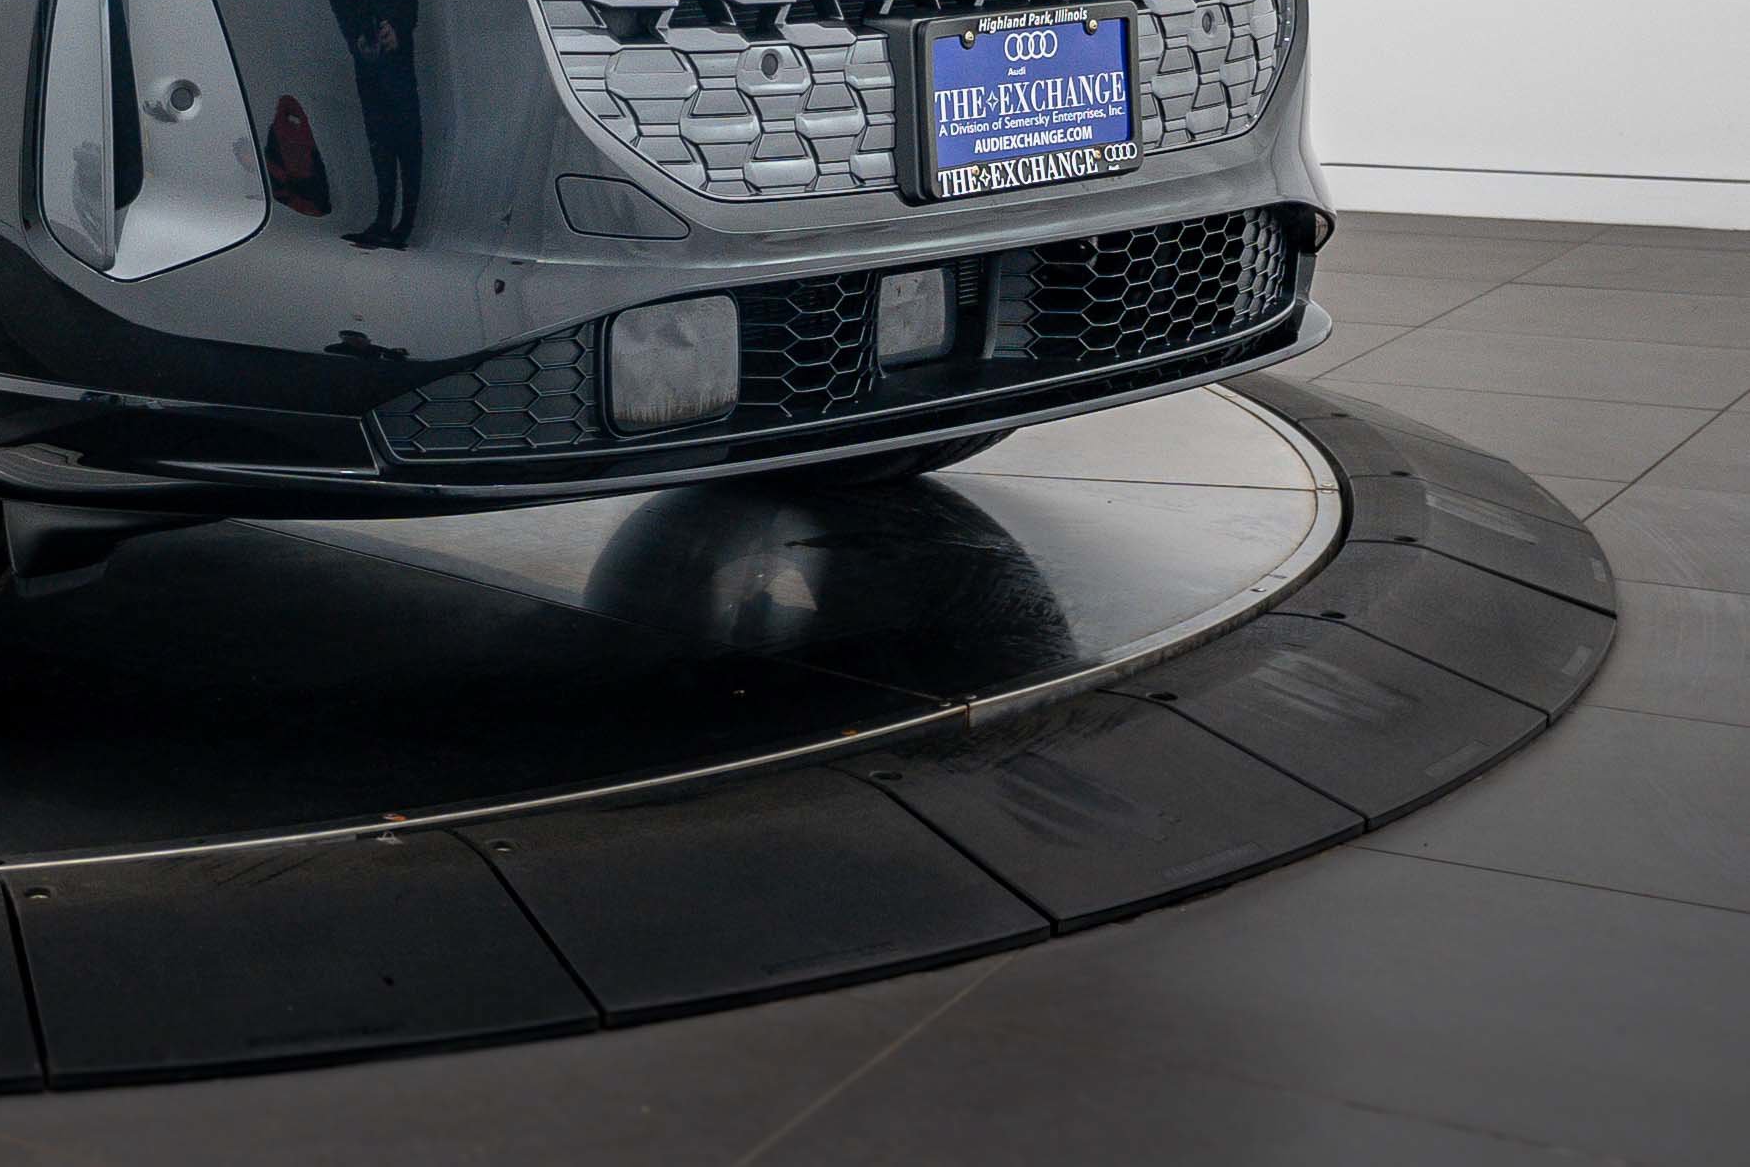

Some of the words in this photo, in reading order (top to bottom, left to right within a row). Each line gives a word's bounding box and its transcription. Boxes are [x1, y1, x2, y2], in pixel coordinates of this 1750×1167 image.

[978, 14, 1027, 34] Highland
[1028, 11, 1054, 26] Park,
[1055, 7, 1088, 23] Illinois
[1008, 66, 1026, 76] Audi
[934, 87, 987, 123] THE
[998, 71, 1126, 116] EXCHANGE
[939, 124, 948, 137] A
[950, 121, 989, 136] Division
[992, 117, 1003, 131] of
[1004, 112, 1050, 127] Semersky
[1053, 108, 1106, 124] Enterprises,
[1109, 104, 1125, 116] Inc.
[974, 126, 1093, 154] AUDIEXCHANGE.COM
[938, 166, 982, 197] THE
[988, 148, 1099, 190] EXCHANGE
